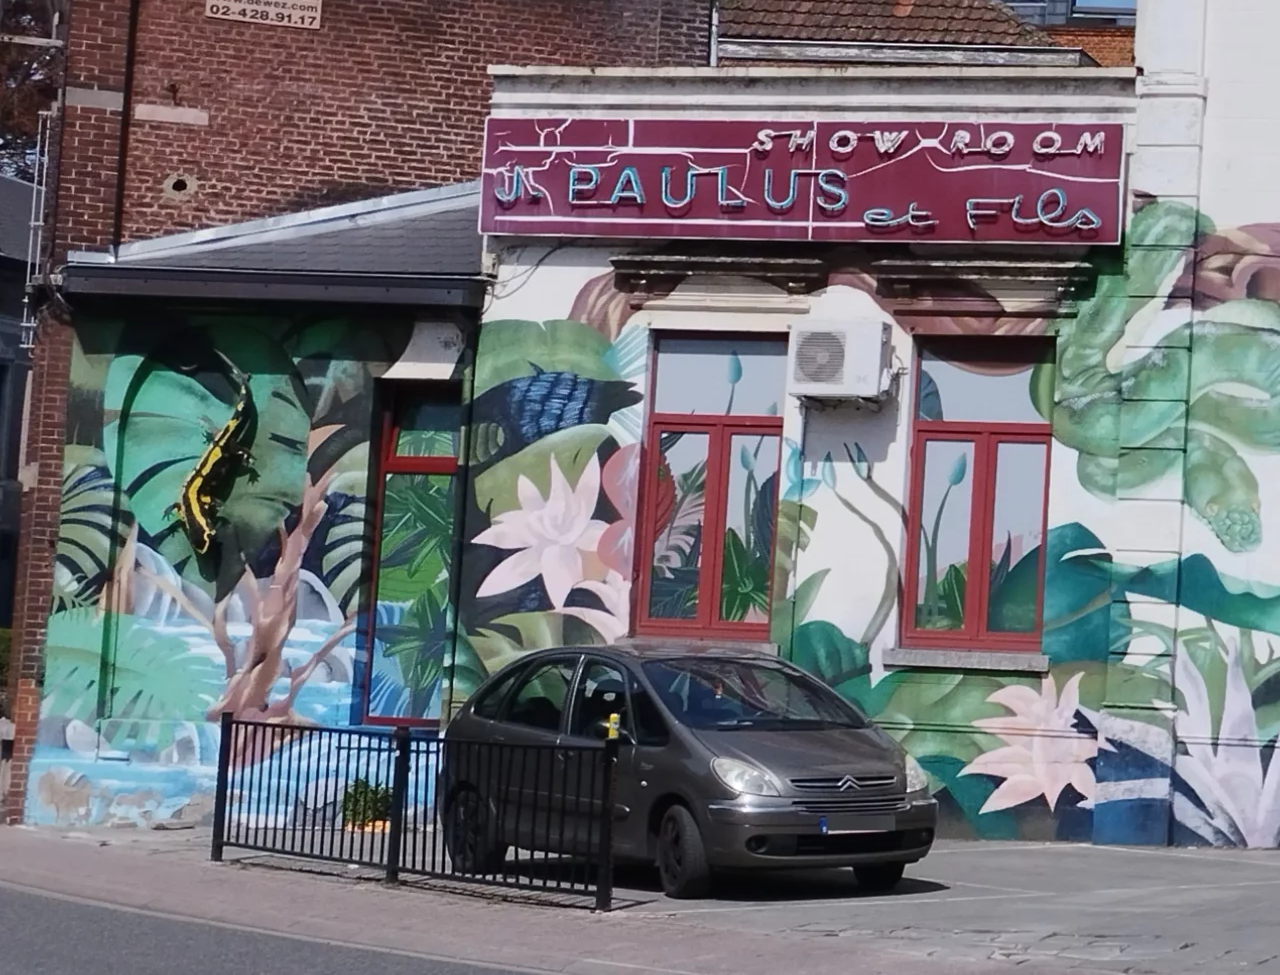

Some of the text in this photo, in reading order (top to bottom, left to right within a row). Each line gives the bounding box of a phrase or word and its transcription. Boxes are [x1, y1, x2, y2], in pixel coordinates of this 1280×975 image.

[209, 4, 317, 26] 02-428.91.17
[752, 129, 1105, 155] SHOW ROOM
[568, 166, 848, 211] PAULUS
[863, 201, 940, 226] et
